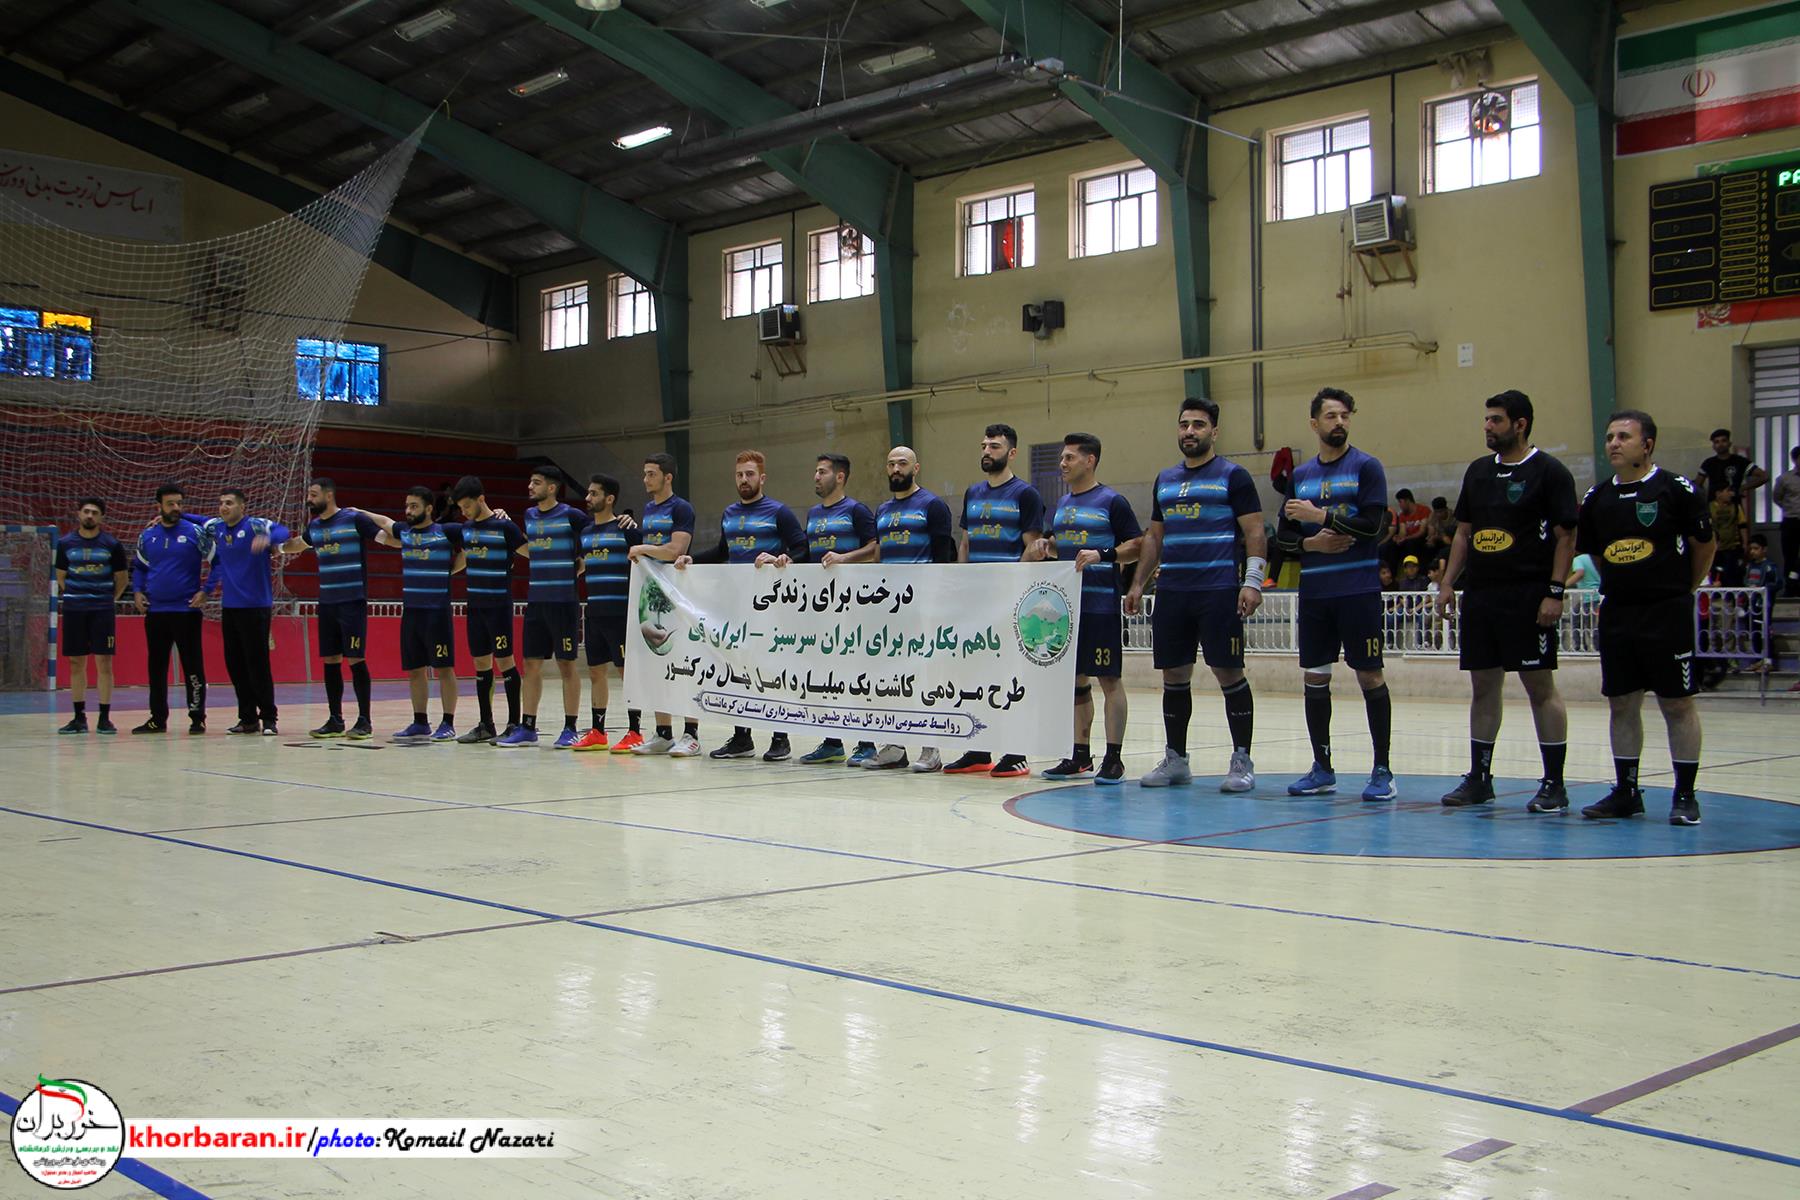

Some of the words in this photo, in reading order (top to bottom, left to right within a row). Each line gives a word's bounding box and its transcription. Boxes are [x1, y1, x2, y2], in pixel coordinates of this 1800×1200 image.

[1617, 554, 1636, 562] MTN
[753, 578, 807, 613] زندگی
[812, 578, 852, 613] برای
[856, 578, 914, 613] درخت
[495, 636, 508, 649] 23
[562, 637, 572, 651] 15
[709, 621, 747, 650] ایران
[821, 623, 862, 656] ایران
[866, 624, 904, 656] برای
[908, 625, 958, 658] بکاریم
[436, 644, 449, 657] 24
[1231, 637, 1240, 656] 11
[1366, 638, 1380, 657] 19
[1094, 648, 1111, 666] 33
[665, 656, 701, 681] کشور
[789, 670, 845, 700] میلیارد
[848, 673, 871, 702] یک
[874, 674, 915, 698] کاشت
[921, 680, 984, 708] مردمی
[987, 676, 1026, 710] طرح
[737, 701, 766, 714] استان
[818, 710, 840, 724] طبیعی
[842, 711, 860, 726] منابع
[862, 712, 873, 727] کل
[875, 714, 895, 729] اداره
[895, 719, 928, 731] عمومی
[929, 716, 961, 734] روابط
